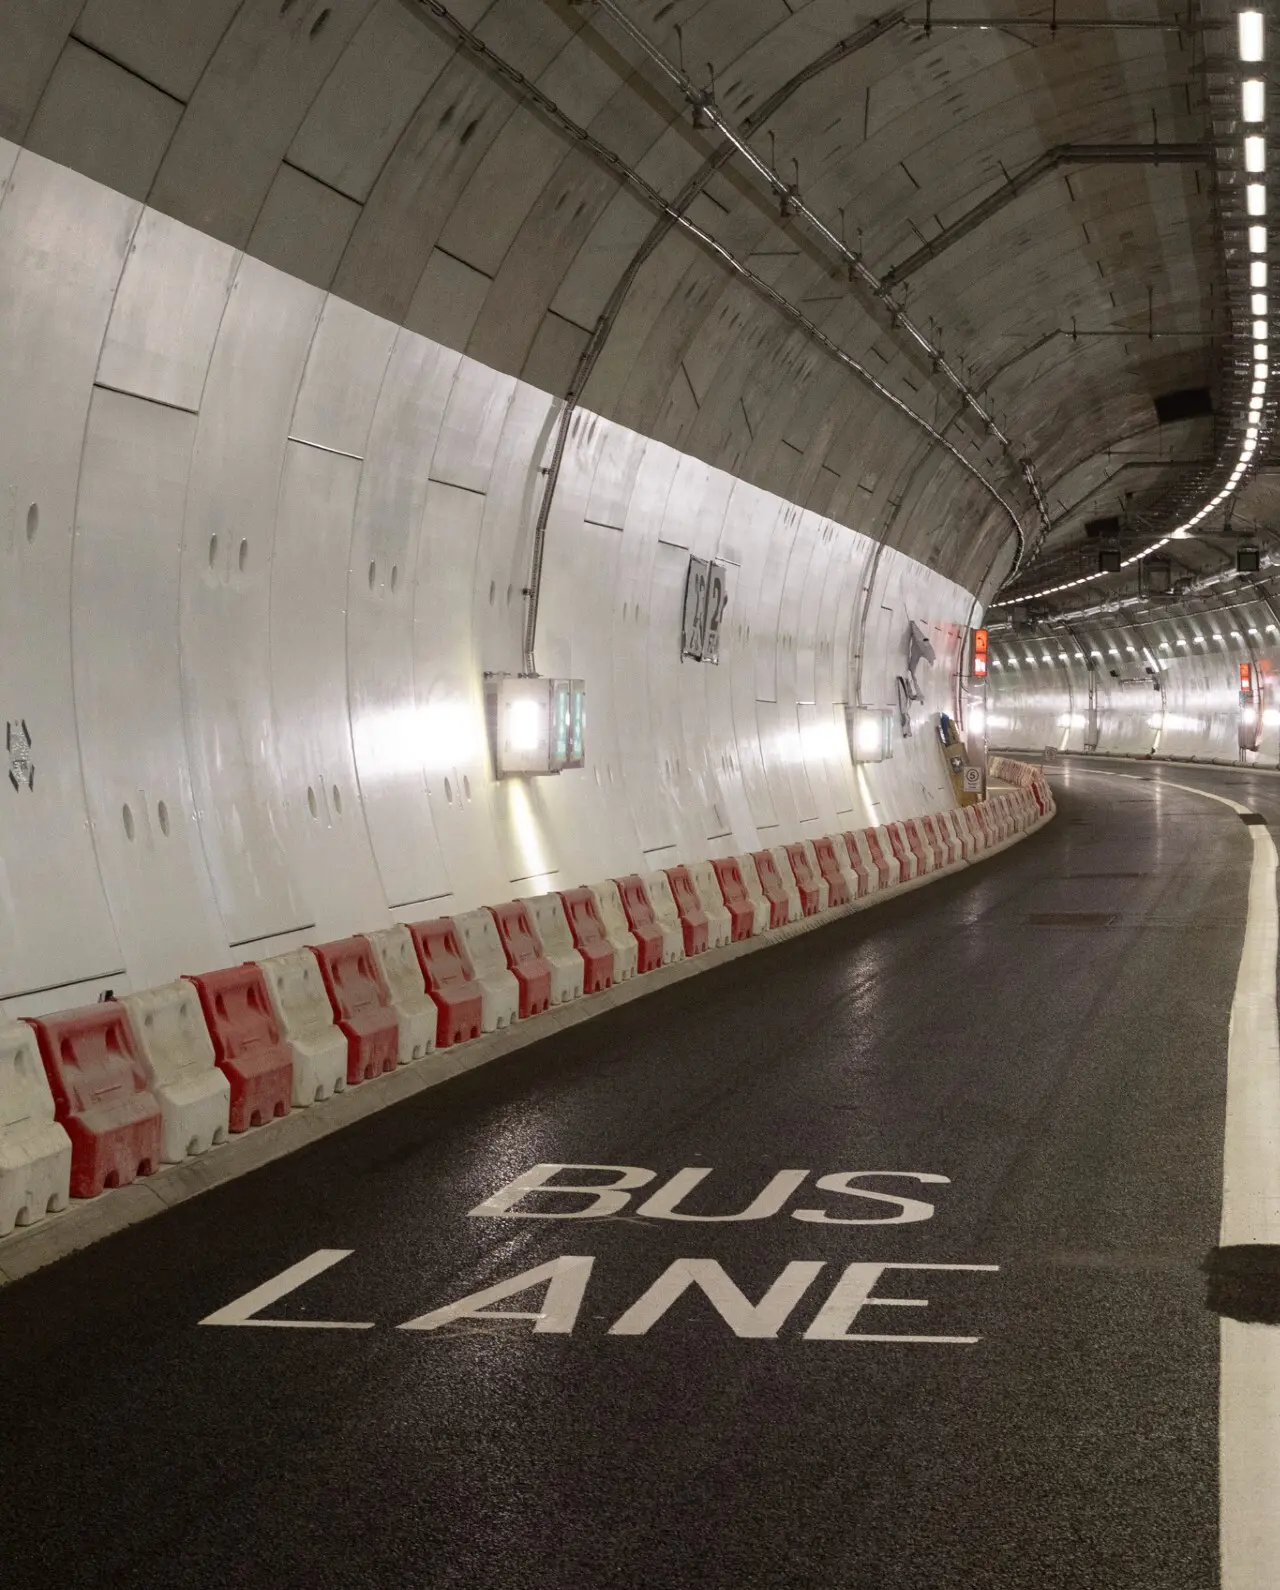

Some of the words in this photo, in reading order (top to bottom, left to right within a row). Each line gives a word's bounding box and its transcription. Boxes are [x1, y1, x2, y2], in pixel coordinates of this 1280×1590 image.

[969, 771, 976, 780] 5
[465, 1163, 952, 1226] BUS
[197, 1249, 1000, 1343] LANE
